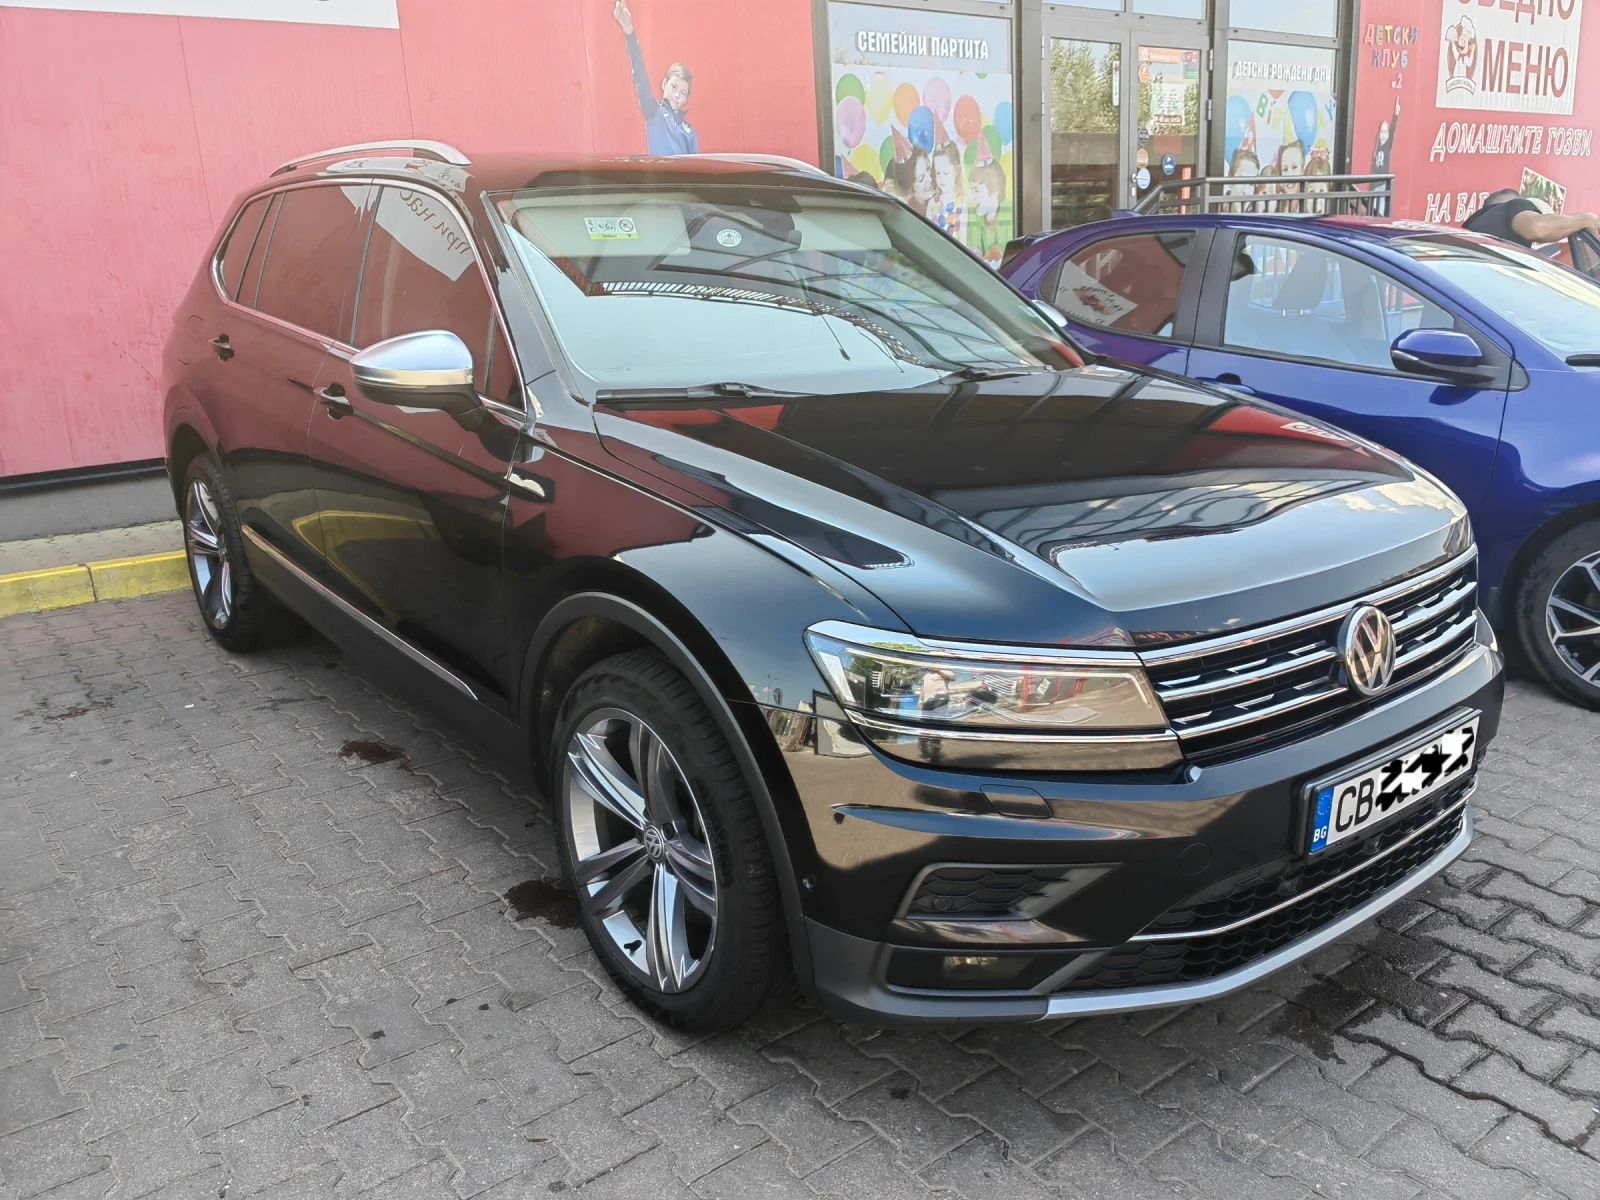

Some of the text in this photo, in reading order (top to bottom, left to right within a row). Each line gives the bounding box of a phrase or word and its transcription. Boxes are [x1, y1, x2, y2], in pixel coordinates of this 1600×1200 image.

[857, 30, 989, 60] СЕМЕЙНИ ПАРТИТА
[1364, 24, 1419, 46] ДЕТСКИ
[1373, 48, 1408, 68] КЛУБ
[1481, 38, 1569, 98] МЕНЮ
[1235, 60, 1331, 84] ДЕТСКИ РОЖДЕНИ ДНИ
[1429, 122, 1593, 163] ДОМАШНИТЕ ГОЗБИ
[1425, 192, 1451, 223] НА
[1312, 825, 1328, 843] BG
